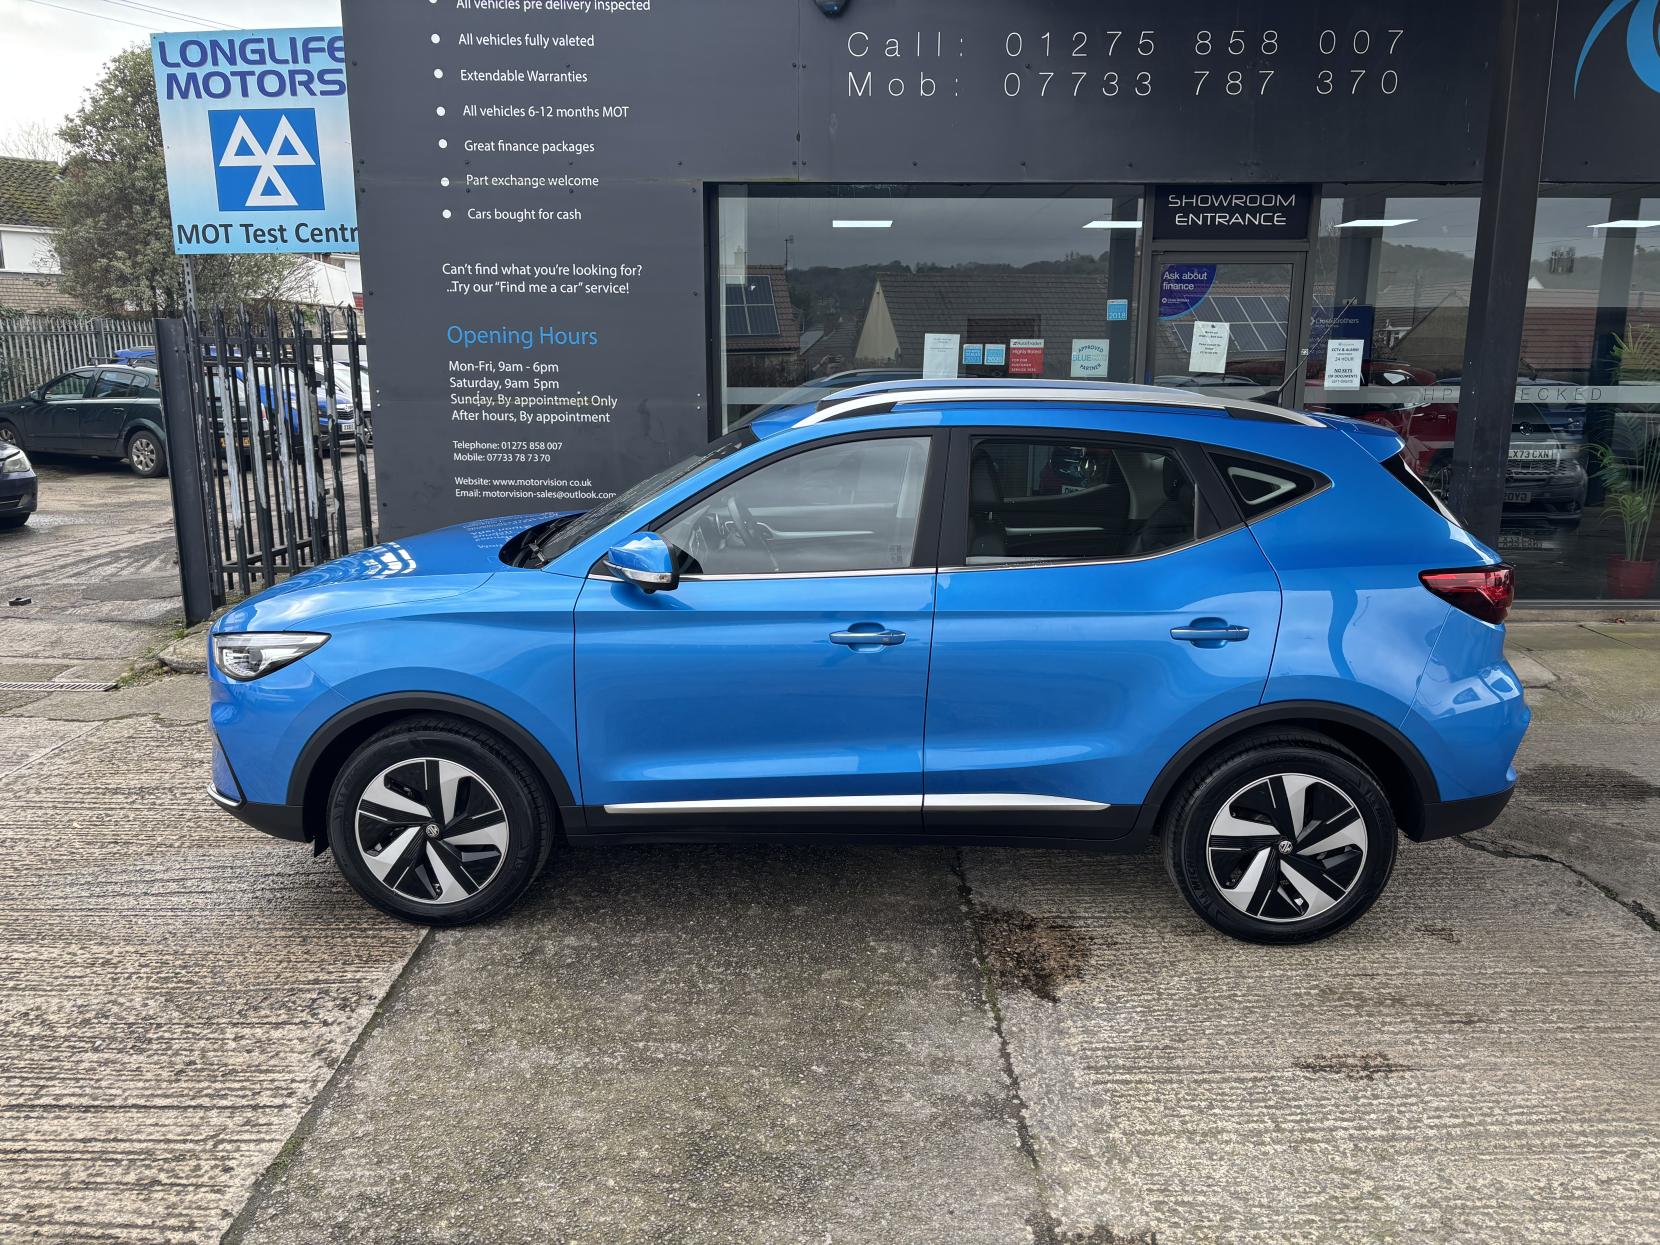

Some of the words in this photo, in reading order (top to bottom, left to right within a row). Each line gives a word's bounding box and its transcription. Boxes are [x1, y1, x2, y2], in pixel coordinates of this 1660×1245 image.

[456, 0, 471, 9] All
[474, 0, 521, 10] vehicles
[523, 0, 543, 12] pre
[545, 0, 591, 13] delivery
[594, 0, 650, 13] inspected
[458, 33, 473, 46] All
[476, 34, 522, 46] vehicles
[524, 34, 550, 49] fully
[552, 35, 595, 47] valeted
[847, 31, 964, 57] Call:
[1006, 31, 1155, 57] 01275
[1195, 30, 1278, 55] 858
[1319, 29, 1404, 54] 007
[158, 35, 345, 68] LONGLIFE
[460, 69, 525, 82] Extendable
[527, 70, 588, 83] Warranties
[848, 71, 959, 97] Mob:
[1004, 71, 1151, 97] 07733
[1193, 70, 1275, 96] 787
[1316, 69, 1398, 95] 370
[166, 68, 347, 100] MOTORS
[463, 105, 477, 117] All
[480, 105, 526, 118] vehicles
[528, 106, 553, 118] 6-12
[556, 106, 600, 118] months
[602, 106, 629, 118] MOT
[464, 140, 495, 152] Great
[498, 139, 539, 152] finance
[542, 140, 595, 155] packages
[466, 174, 489, 186] Part
[491, 175, 546, 189] exchange
[548, 175, 599, 187] welcome
[1168, 194, 1296, 207] SHOWROOM
[467, 208, 492, 220] Cars
[494, 208, 536, 223] bought
[538, 208, 554, 221] for
[556, 209, 582, 221] cash
[1175, 213, 1287, 226] ENTRANCE
[177, 223, 233, 244] MOT
[239, 223, 288, 244] Test
[294, 222, 359, 243] Centr
[475, 263, 498, 275] find
[501, 263, 531, 275] what
[572, 264, 617, 279] looking
[620, 264, 643, 277] for?
[1163, 271, 1180, 280] Ask
[1182, 271, 1208, 280] about
[473, 284, 494, 293] our
[529, 283, 548, 294] me
[550, 284, 558, 294] a
[585, 282, 630, 295] service!
[1163, 281, 1195, 291] finance
[447, 325, 534, 350] Opening
[540, 326, 599, 345] Hours
[449, 360, 496, 374] Mon-Fri,
[498, 361, 523, 372] 9am
[532, 362, 559, 374] 6pm
[449, 377, 502, 391] Saturday,
[504, 378, 529, 389] 9am
[534, 378, 560, 391] 5pm
[450, 393, 495, 407] Sunday,
[497, 394, 512, 407] By
[514, 395, 588, 408] appointment
[591, 395, 618, 409] Only
[1423, 388, 1453, 401] HP
[1520, 387, 1602, 400] ECKED
[452, 410, 479, 422] After
[482, 410, 517, 424] hours,
[519, 411, 534, 424] By
[536, 412, 610, 425] appointment
[452, 440, 500, 451] Telephone:
[501, 441, 527, 450] 01275
[529, 442, 545, 450] 858
[547, 442, 563, 451] 007
[453, 453, 485, 462] Mobile:
[486, 453, 513, 462] 07733
[1532, 450, 1549, 459] CXN
[455, 477, 491, 487] Website:
[455, 489, 481, 498] Email:
